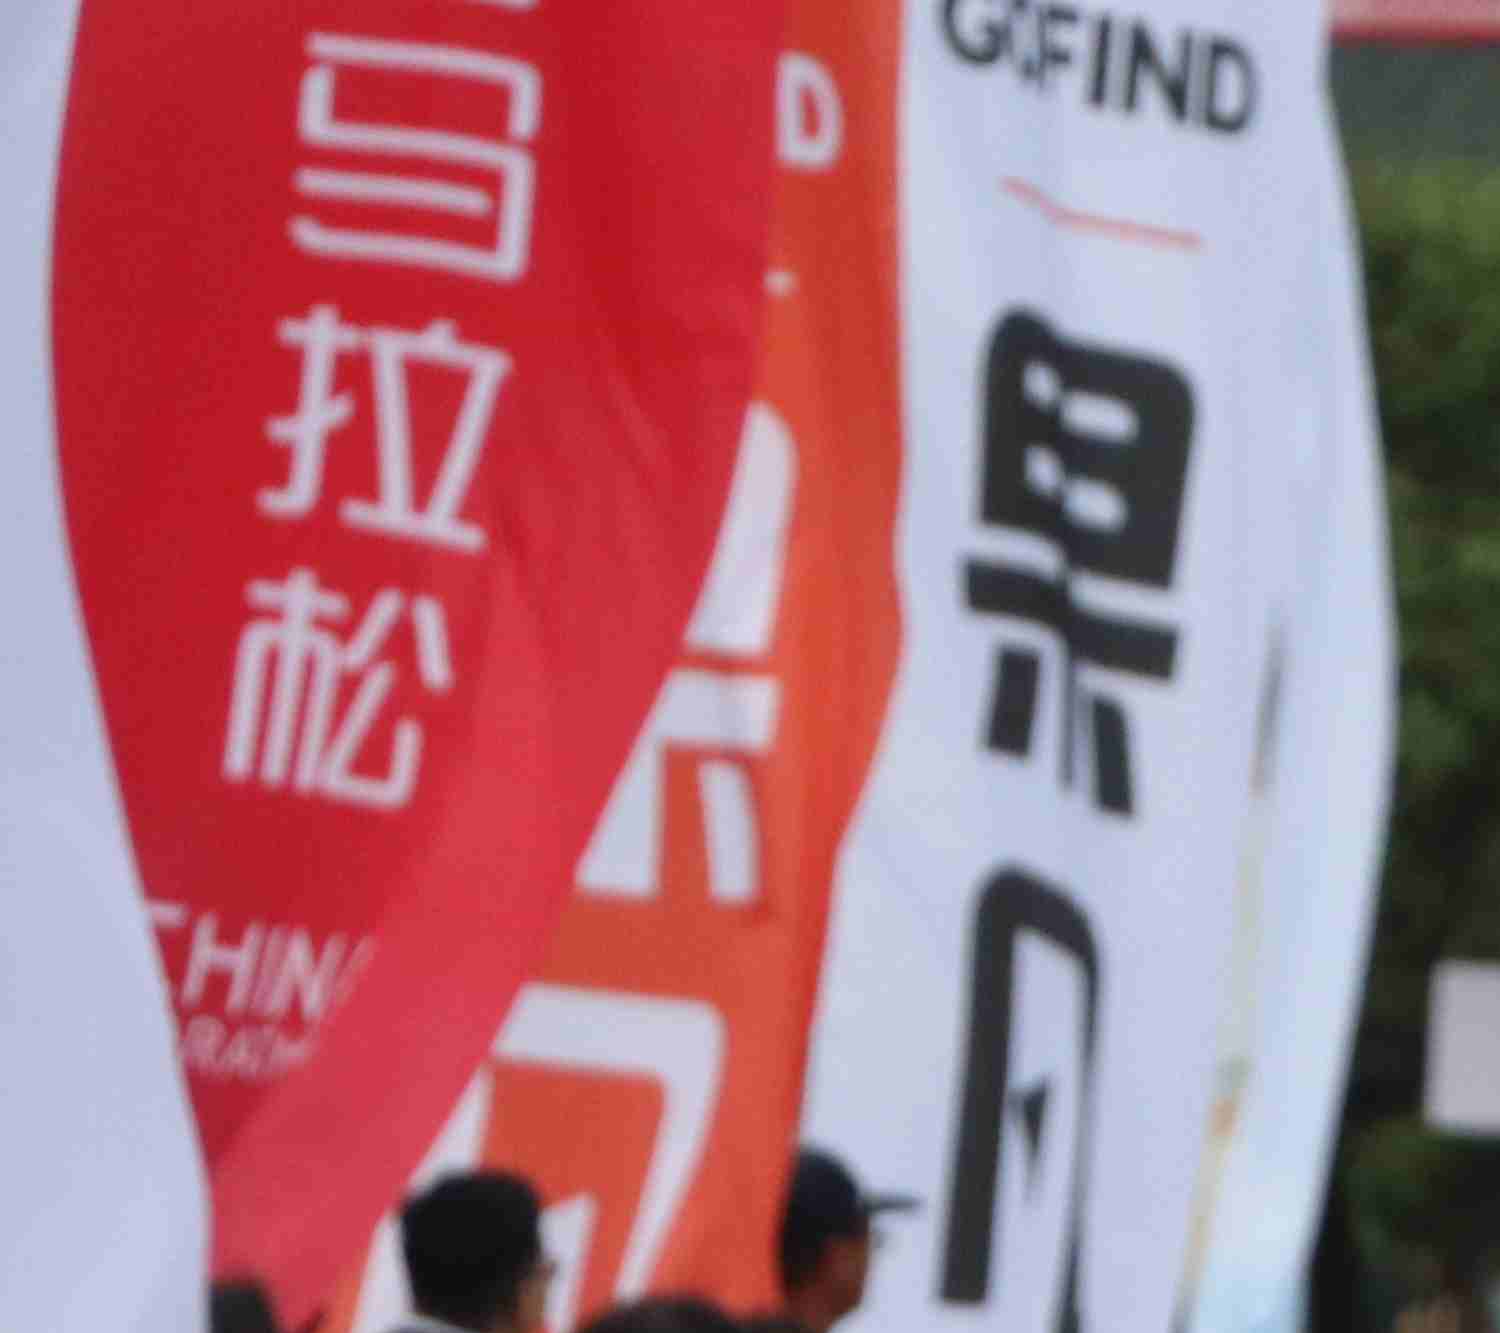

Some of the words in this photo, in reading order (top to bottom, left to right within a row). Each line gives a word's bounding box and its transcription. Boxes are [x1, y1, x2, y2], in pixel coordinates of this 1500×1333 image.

[941, 0, 1258, 132] GFIND
[223, 0, 541, 808] 马拉松
